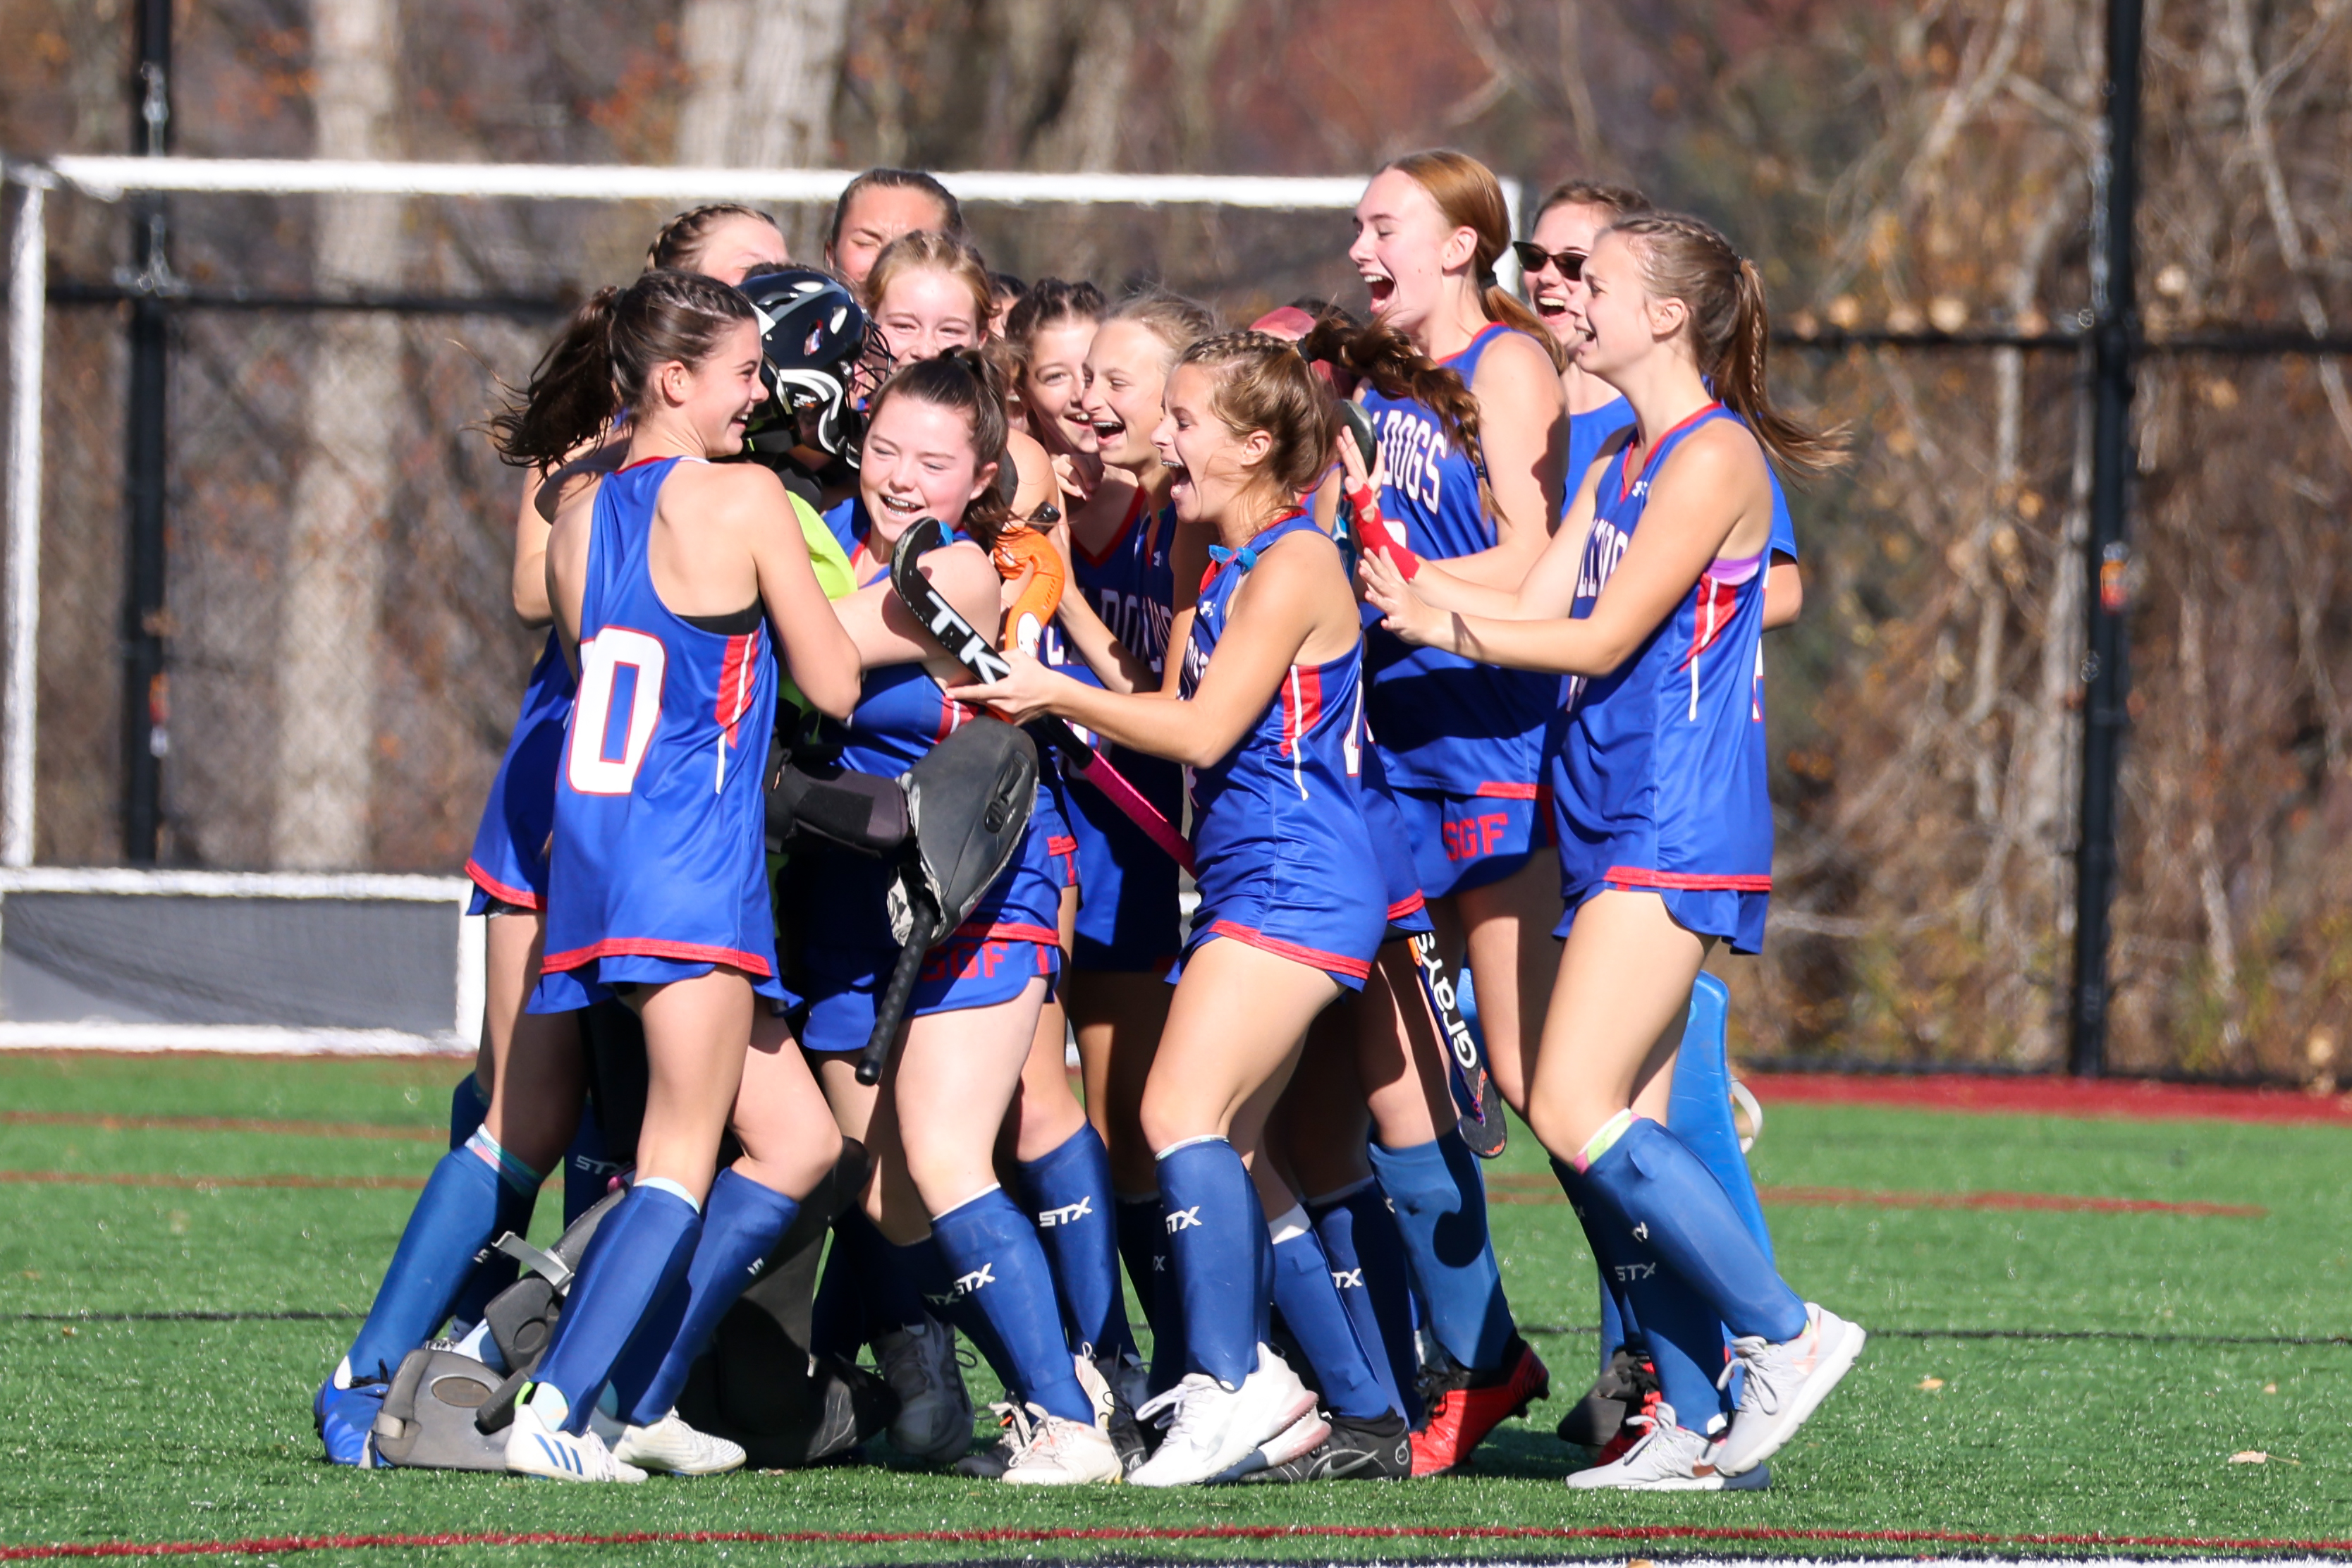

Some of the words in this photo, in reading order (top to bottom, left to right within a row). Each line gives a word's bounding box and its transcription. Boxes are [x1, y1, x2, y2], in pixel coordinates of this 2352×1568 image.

[1373, 408, 1447, 515] DOGS
[926, 589, 1011, 685] TK
[566, 625, 668, 797] 0
[1443, 811, 1509, 862] SGF
[922, 940, 1010, 982] SGF
[574, 1153, 632, 1177] STX
[1039, 1195, 1093, 1227] STX
[953, 1262, 996, 1296] STX
[1331, 1267, 1363, 1289] TX
[1615, 1261, 1656, 1282] STX
